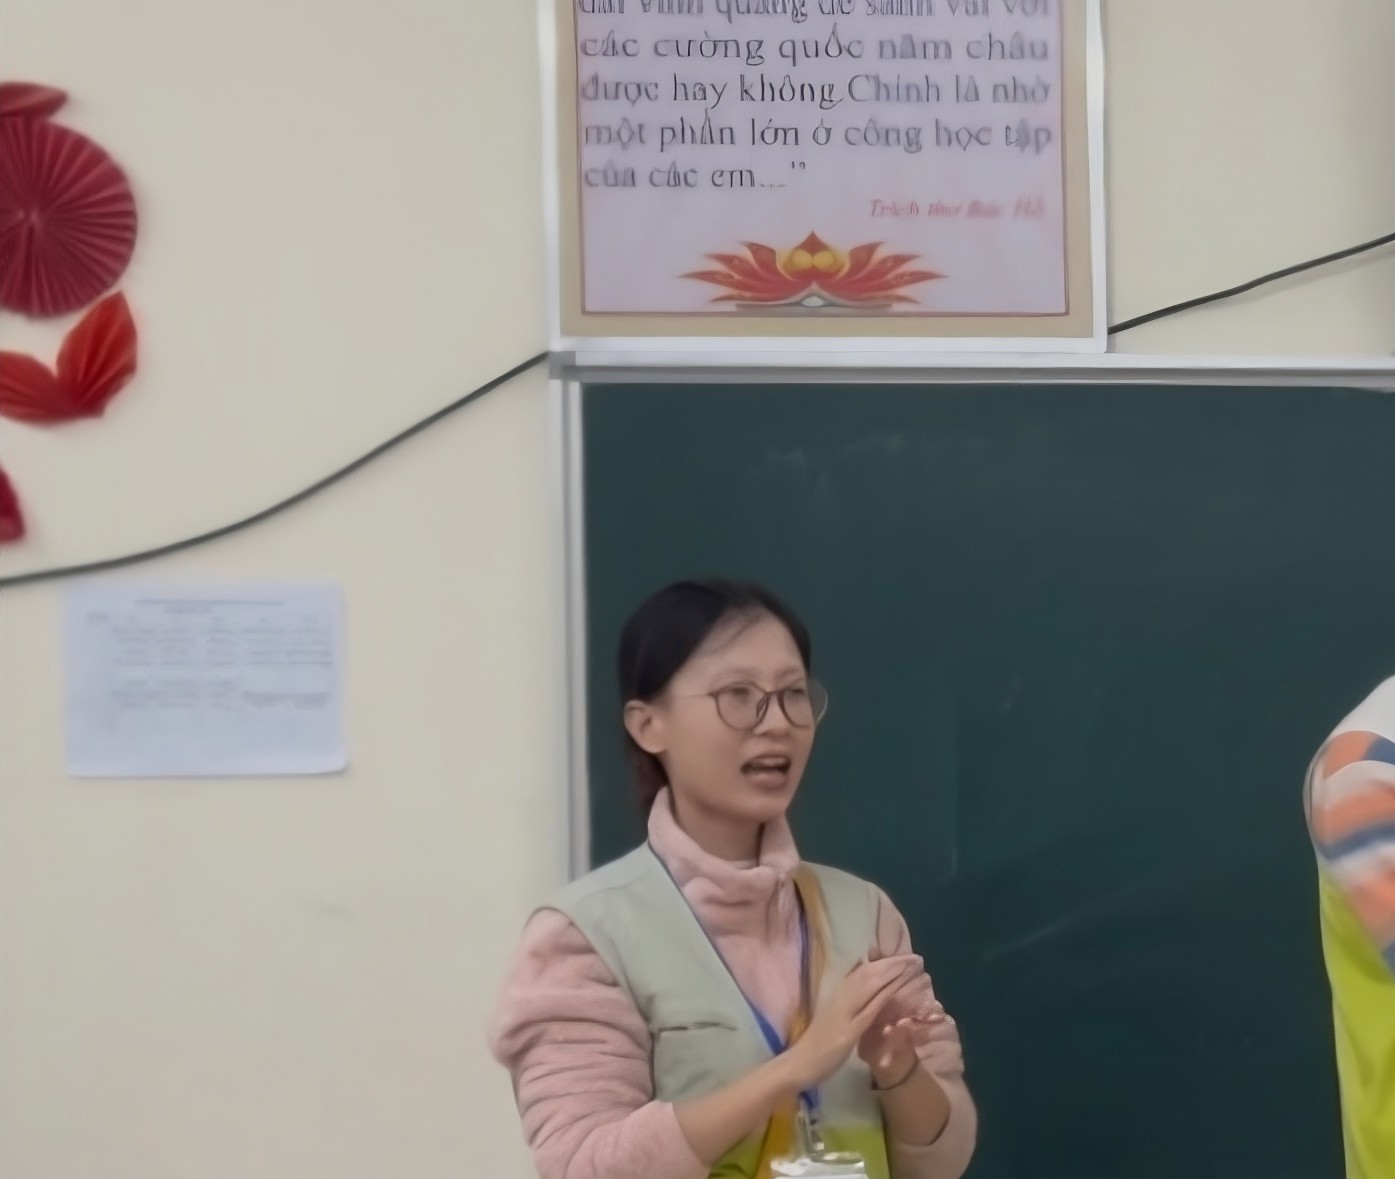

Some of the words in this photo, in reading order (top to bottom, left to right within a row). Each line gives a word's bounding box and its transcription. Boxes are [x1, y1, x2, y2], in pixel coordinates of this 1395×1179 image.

[581, 30, 639, 56] các
[653, 30, 764, 66] cường
[779, 22, 864, 66] quốc
[966, 31, 1048, 60] châu
[581, 73, 658, 107] được
[673, 73, 727, 109] hay
[956, 74, 979, 103] là
[993, 74, 1050, 103] nhờ
[585, 117, 646, 150] một
[660, 108, 735, 152] phần
[751, 118, 799, 145] lớn
[813, 118, 832, 145] ở
[844, 117, 922, 154] công
[935, 118, 992, 151] học
[585, 158, 636, 188] của
[649, 160, 698, 188] các
